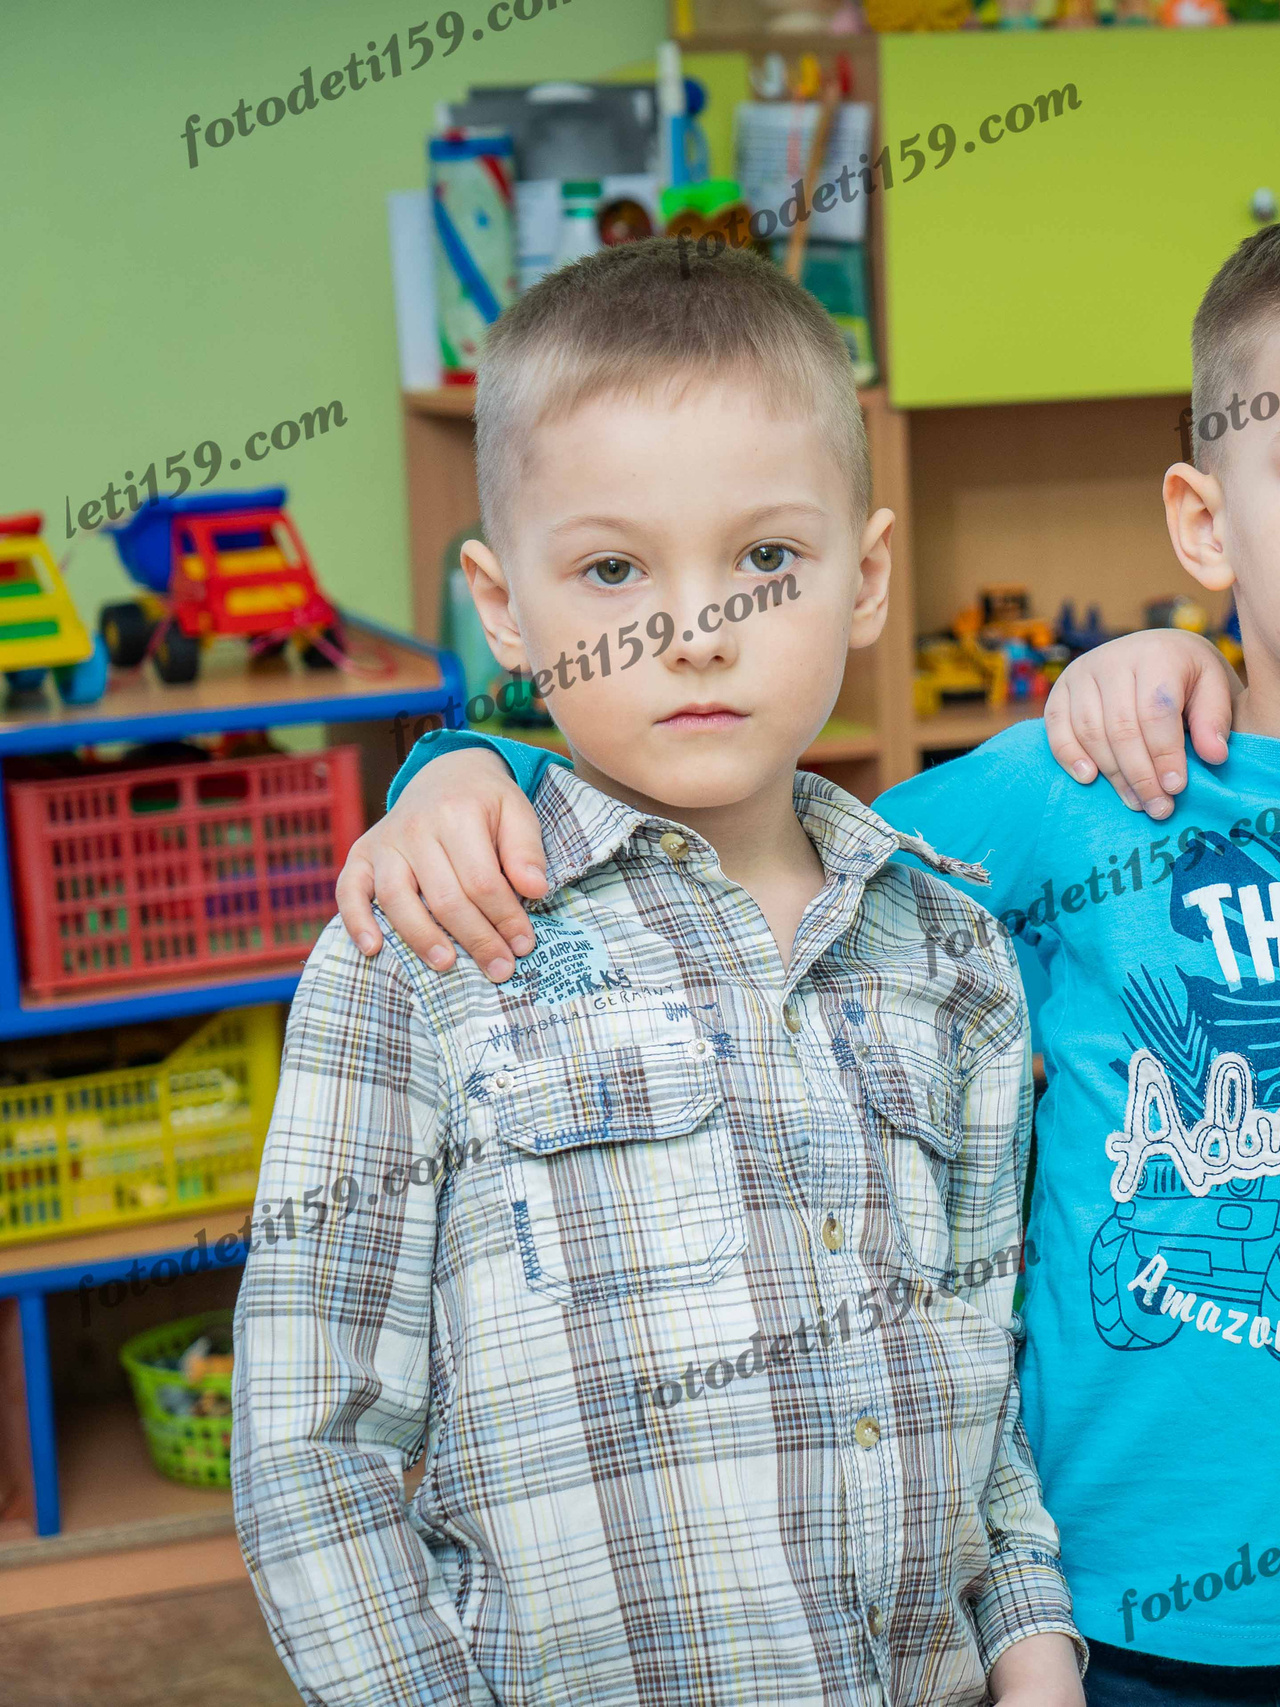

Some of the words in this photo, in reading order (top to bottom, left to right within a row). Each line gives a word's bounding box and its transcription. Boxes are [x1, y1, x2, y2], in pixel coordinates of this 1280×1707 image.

[520, 950, 549, 975] CLUB
[549, 940, 594, 960] AIRPLANE
[548, 952, 589, 971] CONCERT
[564, 960, 585, 972] GYM
[594, 983, 674, 1010] GERMANY
